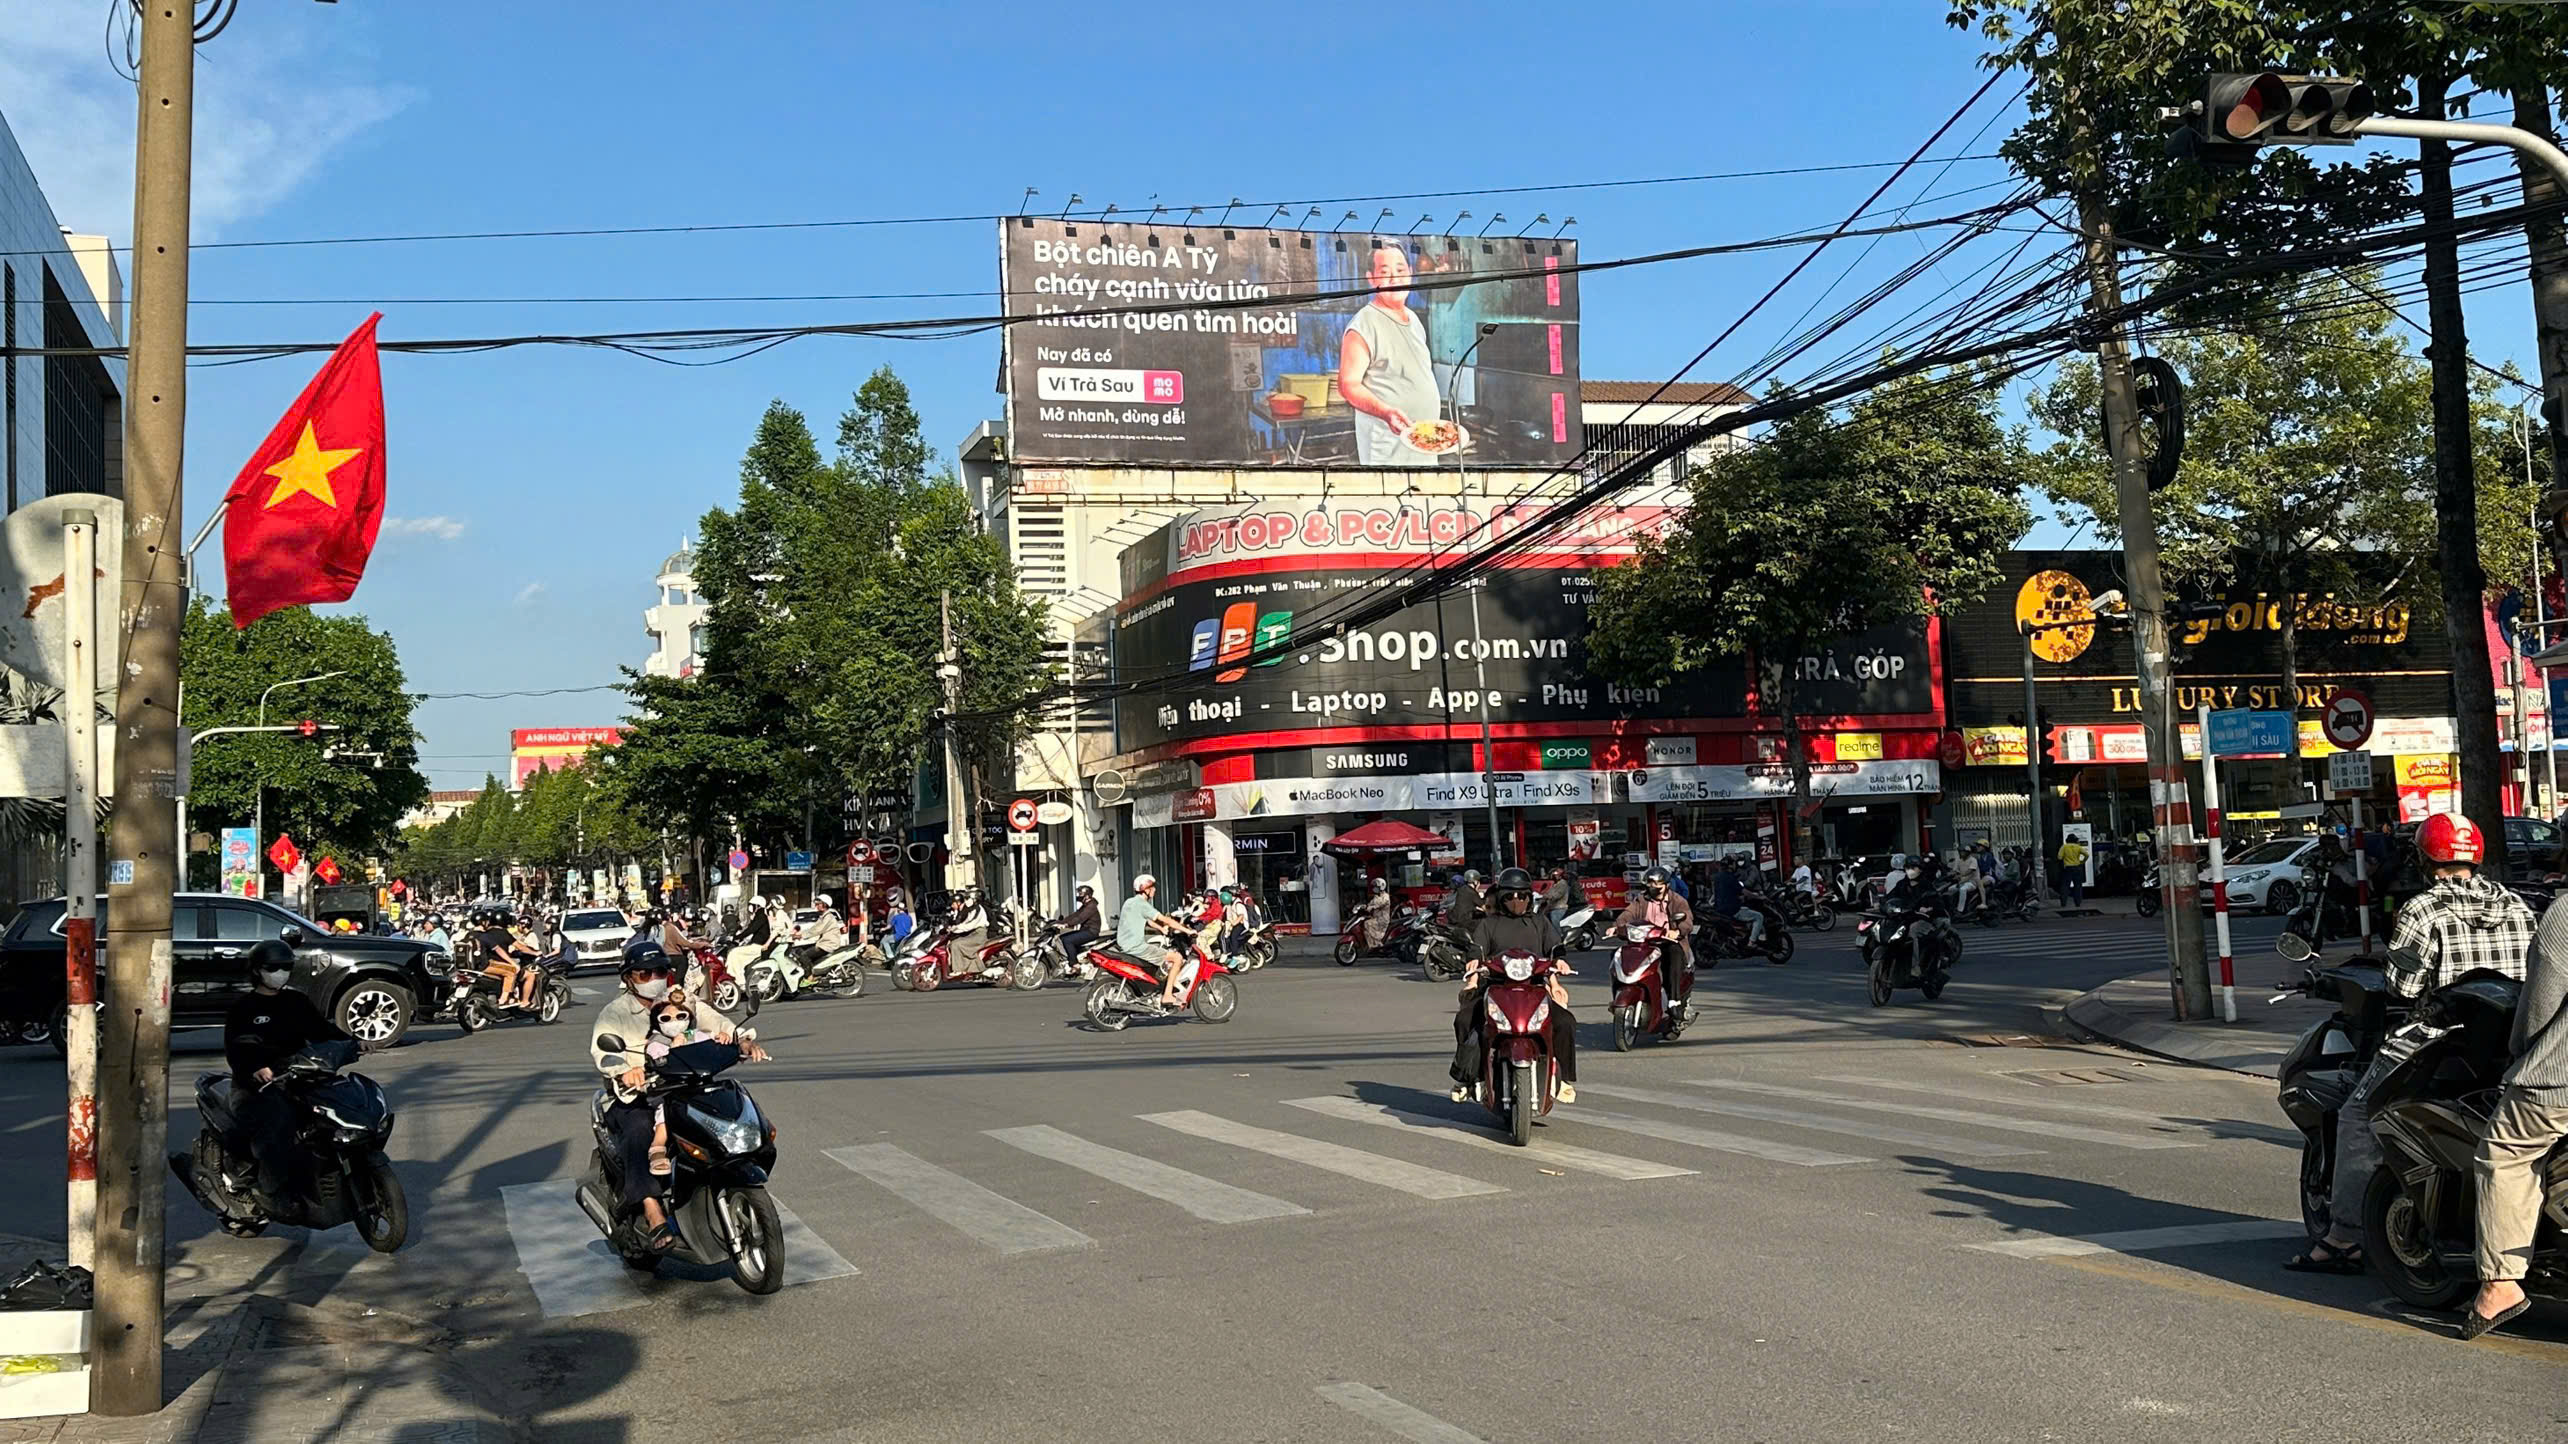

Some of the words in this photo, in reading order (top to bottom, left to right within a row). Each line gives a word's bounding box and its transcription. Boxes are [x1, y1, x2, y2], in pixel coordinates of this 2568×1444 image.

[1034, 240, 1081, 268] Bột
[1086, 243, 1156, 268] chiên
[1163, 246, 1182, 268] A
[1186, 246, 1219, 274] Tỷ
[1034, 272, 1100, 301] cháy
[1105, 276, 1169, 303] cạnh
[1174, 277, 1222, 301] vừa
[1123, 310, 1188, 334] quen
[1194, 310, 1236, 332] tìm
[1242, 311, 1297, 334] hoài
[1037, 346, 1067, 364] Nay
[1071, 347, 1090, 362] đã
[1094, 349, 1112, 362] có
[1049, 376, 1066, 391] Ví
[1070, 376, 1097, 392] Trả
[1101, 378, 1134, 393] Sau
[1039, 406, 1065, 422] Mở
[1068, 408, 1119, 424] nhanh,
[1122, 409, 1159, 427] dùng
[1163, 407, 1186, 425] dễ!
[1178, 513, 1296, 559] LAPTOP
[1303, 513, 1332, 544] &
[1340, 510, 1480, 547] PC/LCD
[1244, 584, 1267, 596] Phạm
[1272, 581, 1288, 592] Văn
[1562, 592, 1579, 605] TƯ
[1854, 648, 1905, 680] GÓP
[1189, 696, 1242, 723] thoại
[1292, 690, 1387, 714] Laptop
[1428, 687, 1502, 713] Appe
[1542, 684, 1588, 710] Phụ
[526, 733, 548, 743] ANH
[548, 731, 569, 742] NGỮ
[570, 730, 593, 742] VIỆT
[1653, 746, 1692, 755] HONOR
[1839, 742, 1879, 752] realme
[1326, 753, 1408, 769] SAMSUNG
[1697, 781, 1709, 799] 5
[1905, 774, 1923, 791] 12
[1300, 788, 1357, 801] MacBook
[1360, 787, 1384, 799] Neo
[1427, 787, 1455, 801] Find
[1460, 785, 1477, 800] X9
[1481, 784, 1513, 799] Utra
[1523, 783, 1551, 798] Find
[1555, 782, 1581, 797] X9s
[1661, 824, 1671, 839] 5
[1761, 845, 1774, 855] 24
